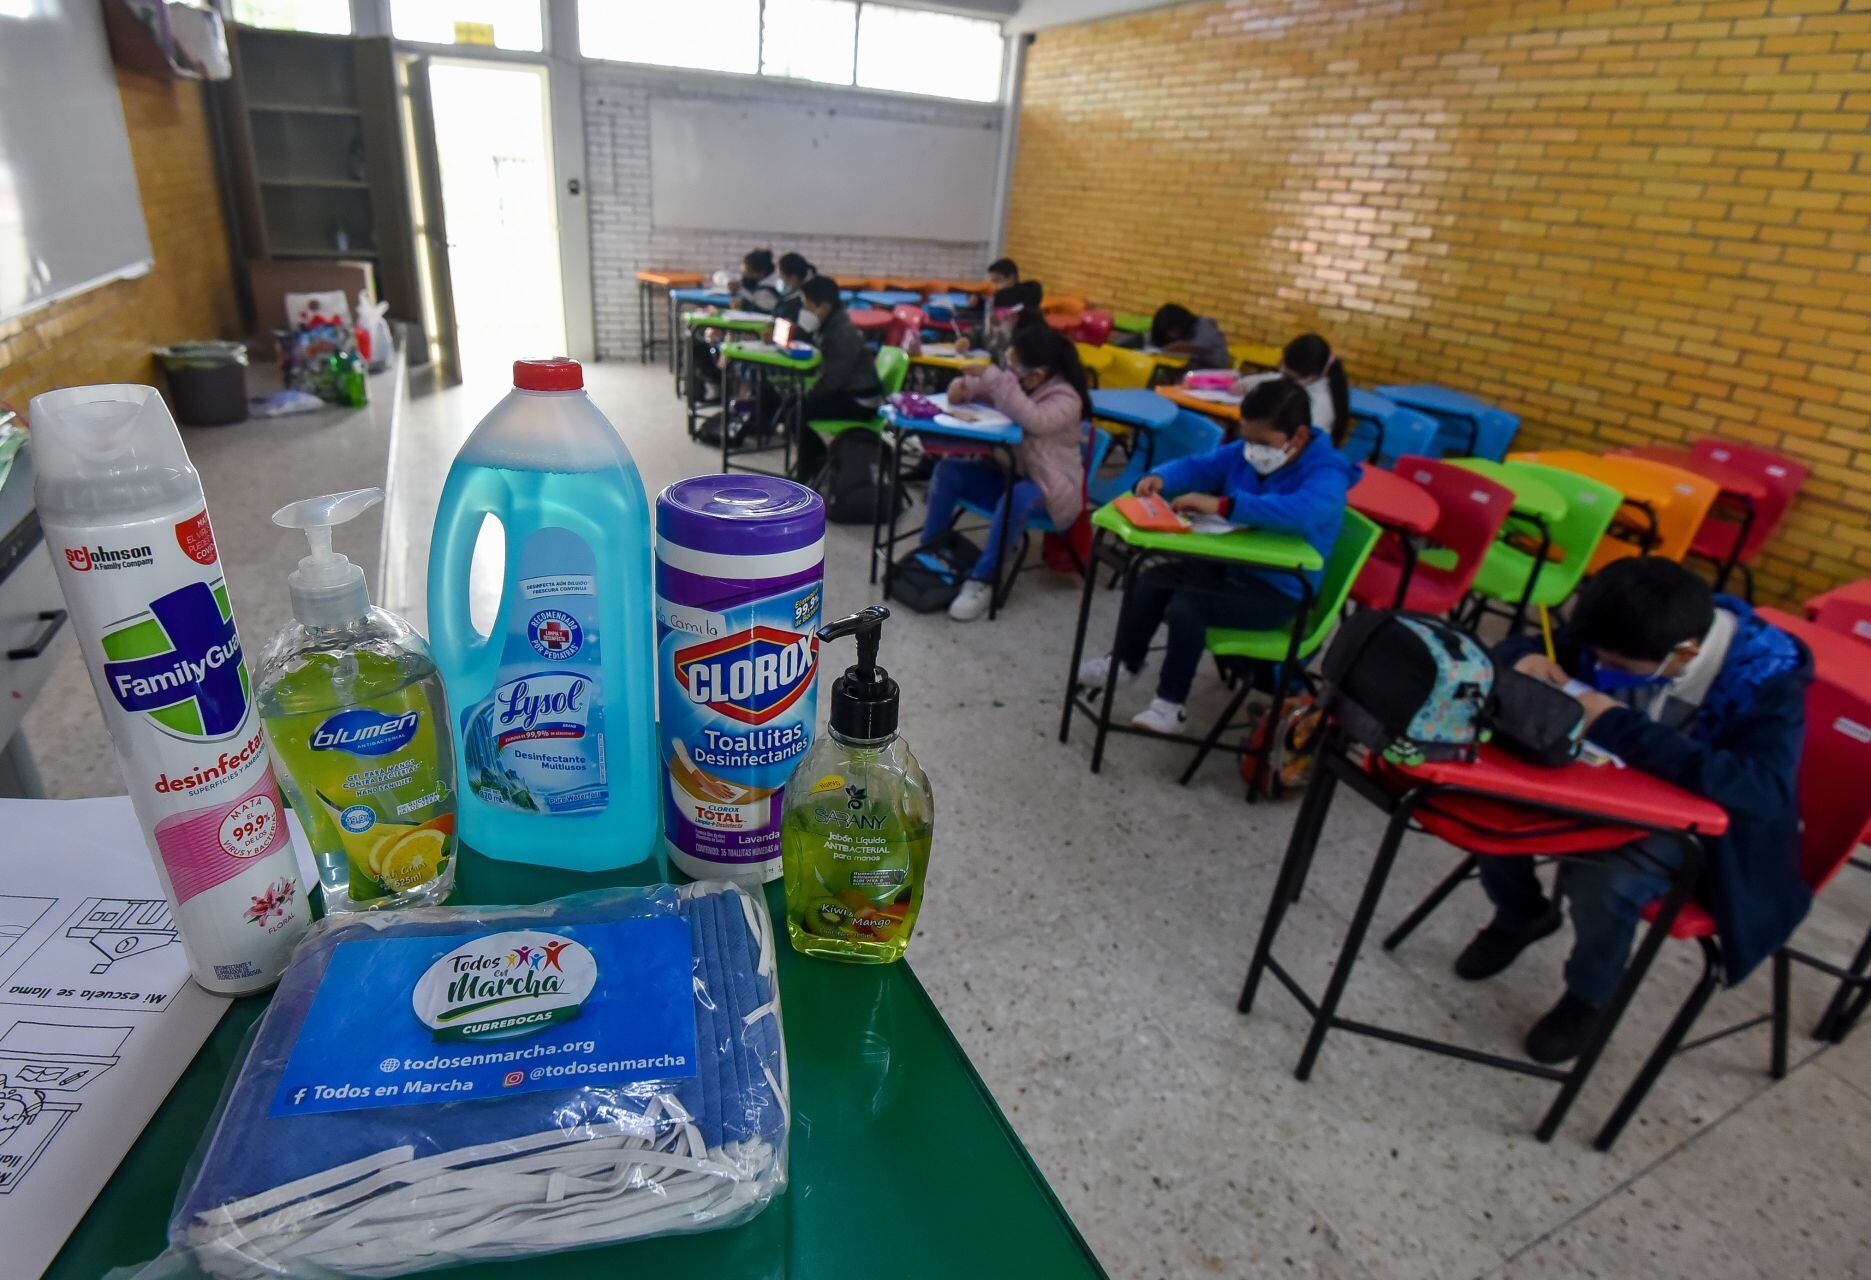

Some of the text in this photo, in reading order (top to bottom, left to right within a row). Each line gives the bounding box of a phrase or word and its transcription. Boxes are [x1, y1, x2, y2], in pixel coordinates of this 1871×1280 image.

[100, 561, 122, 570] Family
[122, 558, 154, 569] Company
[530, 611, 578, 630] RECOMENDADO
[670, 614, 718, 637] Camila
[531, 639, 579, 660] POR PEDIATRAS
[115, 633, 241, 698] FamilyGua
[688, 625, 816, 703] CLOROX
[498, 680, 585, 731] Lysol
[313, 714, 416, 747] blumen
[704, 723, 802, 752] Toallitas
[357, 733, 406, 749] ANTIBACTERIAL
[155, 726, 264, 794] desinfectan
[514, 749, 586, 763] Desinfectante
[695, 737, 808, 766] Desinfectantes
[541, 762, 587, 771] Multiusos
[189, 772, 239, 797] SUPERFICIES
[342, 778, 375, 789] CONTRA
[347, 774, 362, 783] GEL
[356, 787, 378, 797] HAND
[566, 791, 601, 802] Waterfall
[231, 798, 262, 820] MATA
[695, 806, 743, 822] TOTAL
[708, 804, 740, 813] CLOROX
[233, 811, 271, 841] 99.9%
[245, 830, 267, 846] DE LOS
[738, 831, 781, 844] Lavanda
[828, 831, 886, 845] Jabón Líquido
[223, 840, 245, 856] VIRUS
[833, 852, 852, 861] para
[822, 903, 848, 916] Kiwi
[268, 912, 295, 935] FLORAL
[851, 918, 891, 929] Mango
[447, 954, 501, 973] Todos
[8, 986, 167, 1004] Mi escuela se llama
[447, 969, 565, 1002] Marcha
[462, 1012, 552, 1034] CUBREBOCAS
[403, 1040, 595, 1071] todosenmarcha.org
[530, 1054, 686, 1080] @todosenmarcha
[314, 1084, 371, 1100] Todos
[375, 1085, 398, 1097] en
[403, 1079, 473, 1094] Marcha
